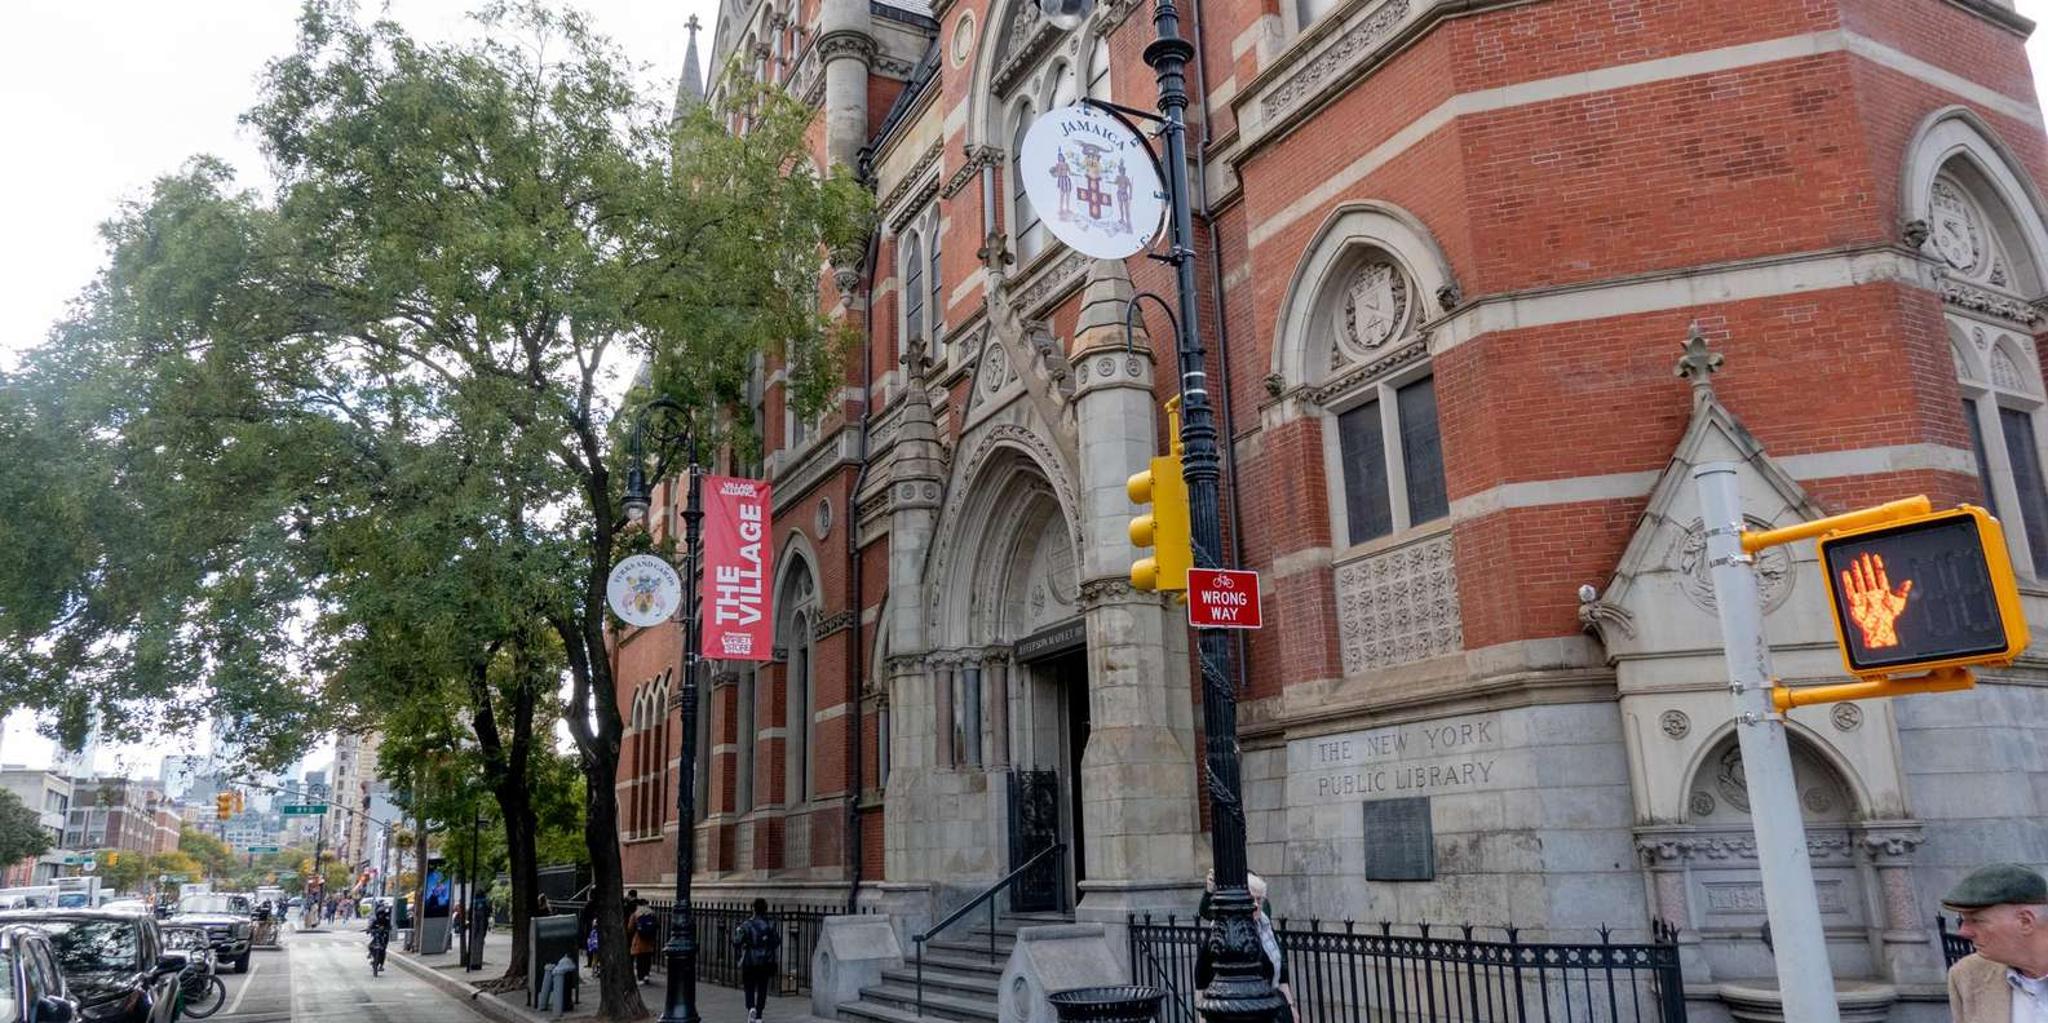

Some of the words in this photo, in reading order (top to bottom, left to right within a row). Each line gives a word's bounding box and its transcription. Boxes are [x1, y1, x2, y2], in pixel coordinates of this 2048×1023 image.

[1060, 120, 1125, 151] JAMAICA
[636, 560, 653, 568] AND
[739, 505, 762, 626] VILLAGE
[716, 565, 740, 624] THE
[1201, 590, 1248, 606] WRONG
[1211, 606, 1239, 621] WAY
[1318, 740, 1352, 762] THE
[1367, 732, 1408, 757] NEW
[1423, 721, 1493, 750] YORK
[1318, 771, 1388, 797] PUBLIC
[1395, 760, 1495, 791] LIBRARY
